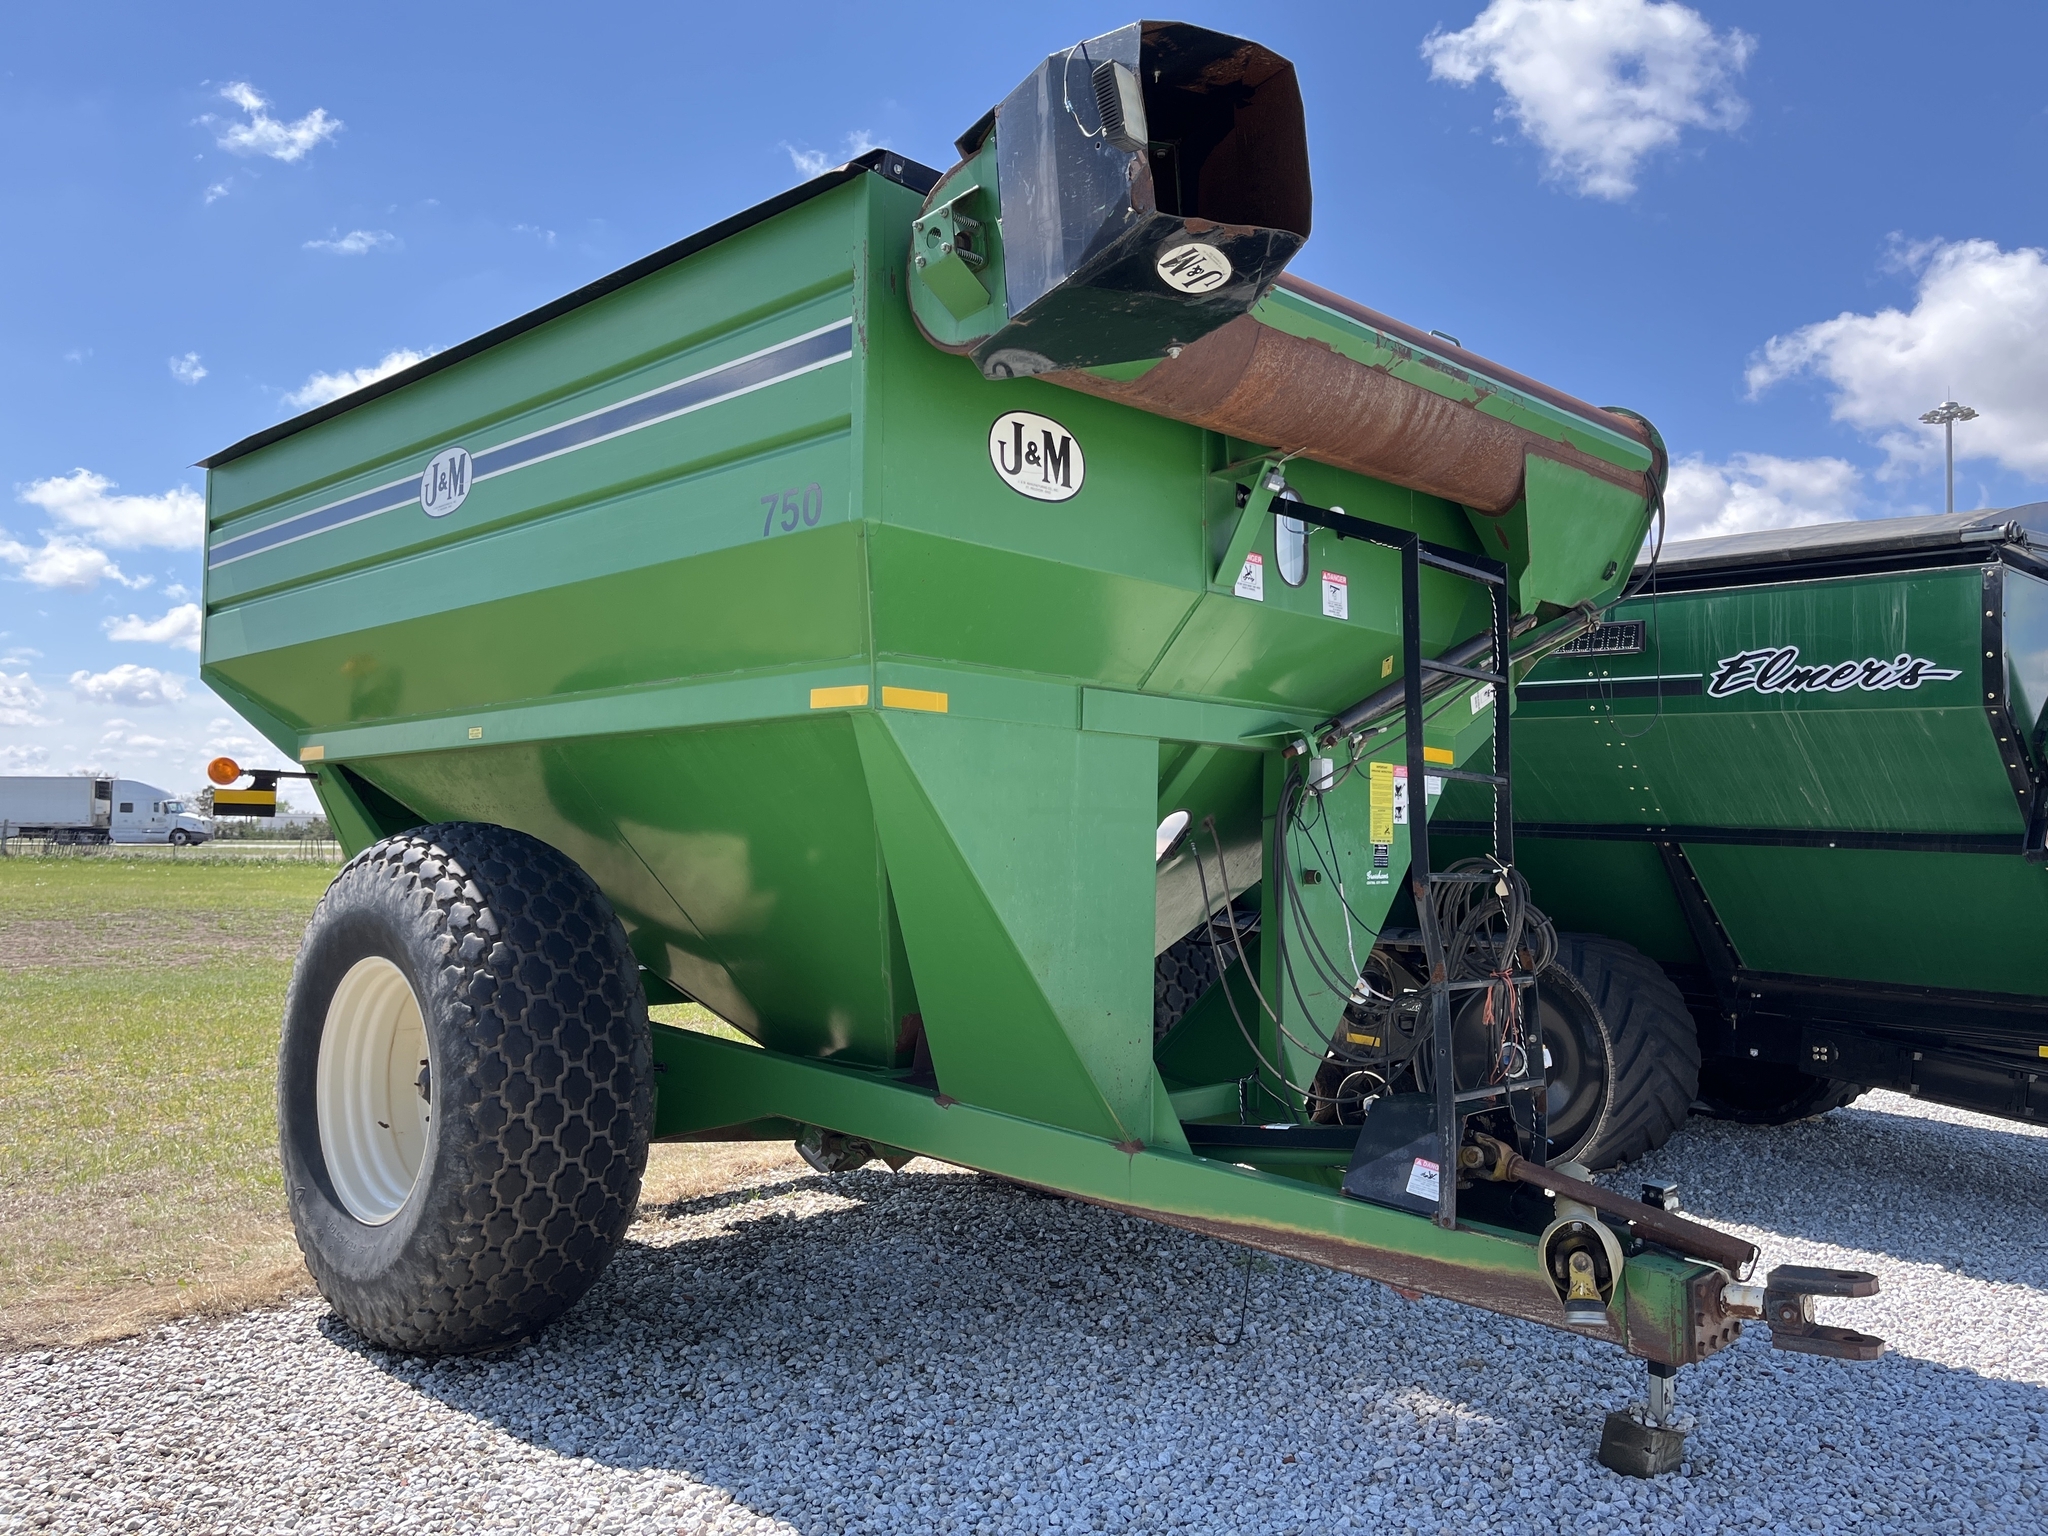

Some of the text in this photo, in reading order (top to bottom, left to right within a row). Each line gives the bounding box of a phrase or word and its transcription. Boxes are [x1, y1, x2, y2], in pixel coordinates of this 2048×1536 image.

[1159, 246, 1225, 290] J&M
[997, 420, 1073, 489] J&M
[424, 452, 467, 507] J&M
[760, 481, 823, 537] 750
[1246, 553, 1263, 564] NGER
[1326, 572, 1347, 584] DANGER
[1708, 646, 1962, 698] Elmer's
[1423, 1160, 1439, 1170] DANG
